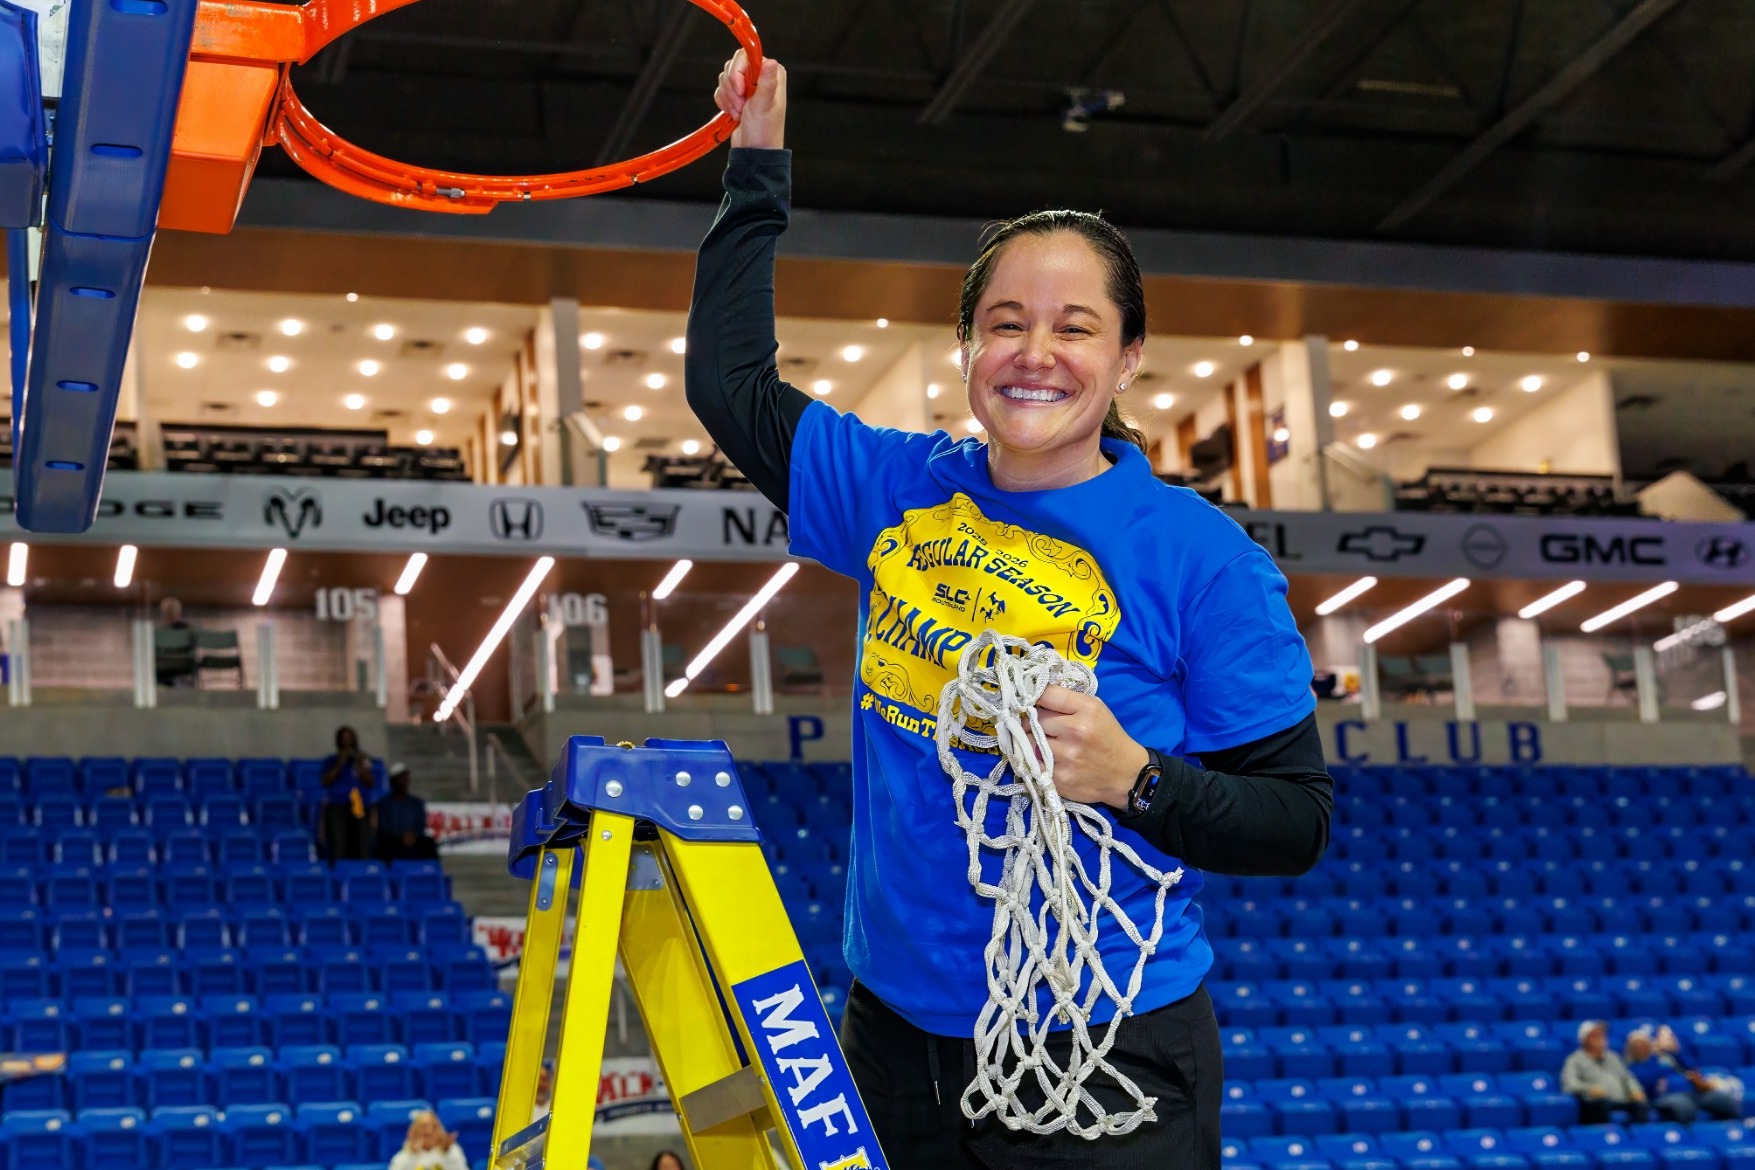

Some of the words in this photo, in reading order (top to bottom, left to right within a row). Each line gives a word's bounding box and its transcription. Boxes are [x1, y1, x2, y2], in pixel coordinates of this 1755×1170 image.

[363, 499, 451, 535] Jeep
[1539, 533, 1666, 566] GMC
[314, 587, 378, 621] 105
[935, 582, 971, 605] SLC
[983, 556, 1081, 619] SEASON
[1334, 720, 1543, 764] CLUB
[751, 983, 859, 1138] MAF
